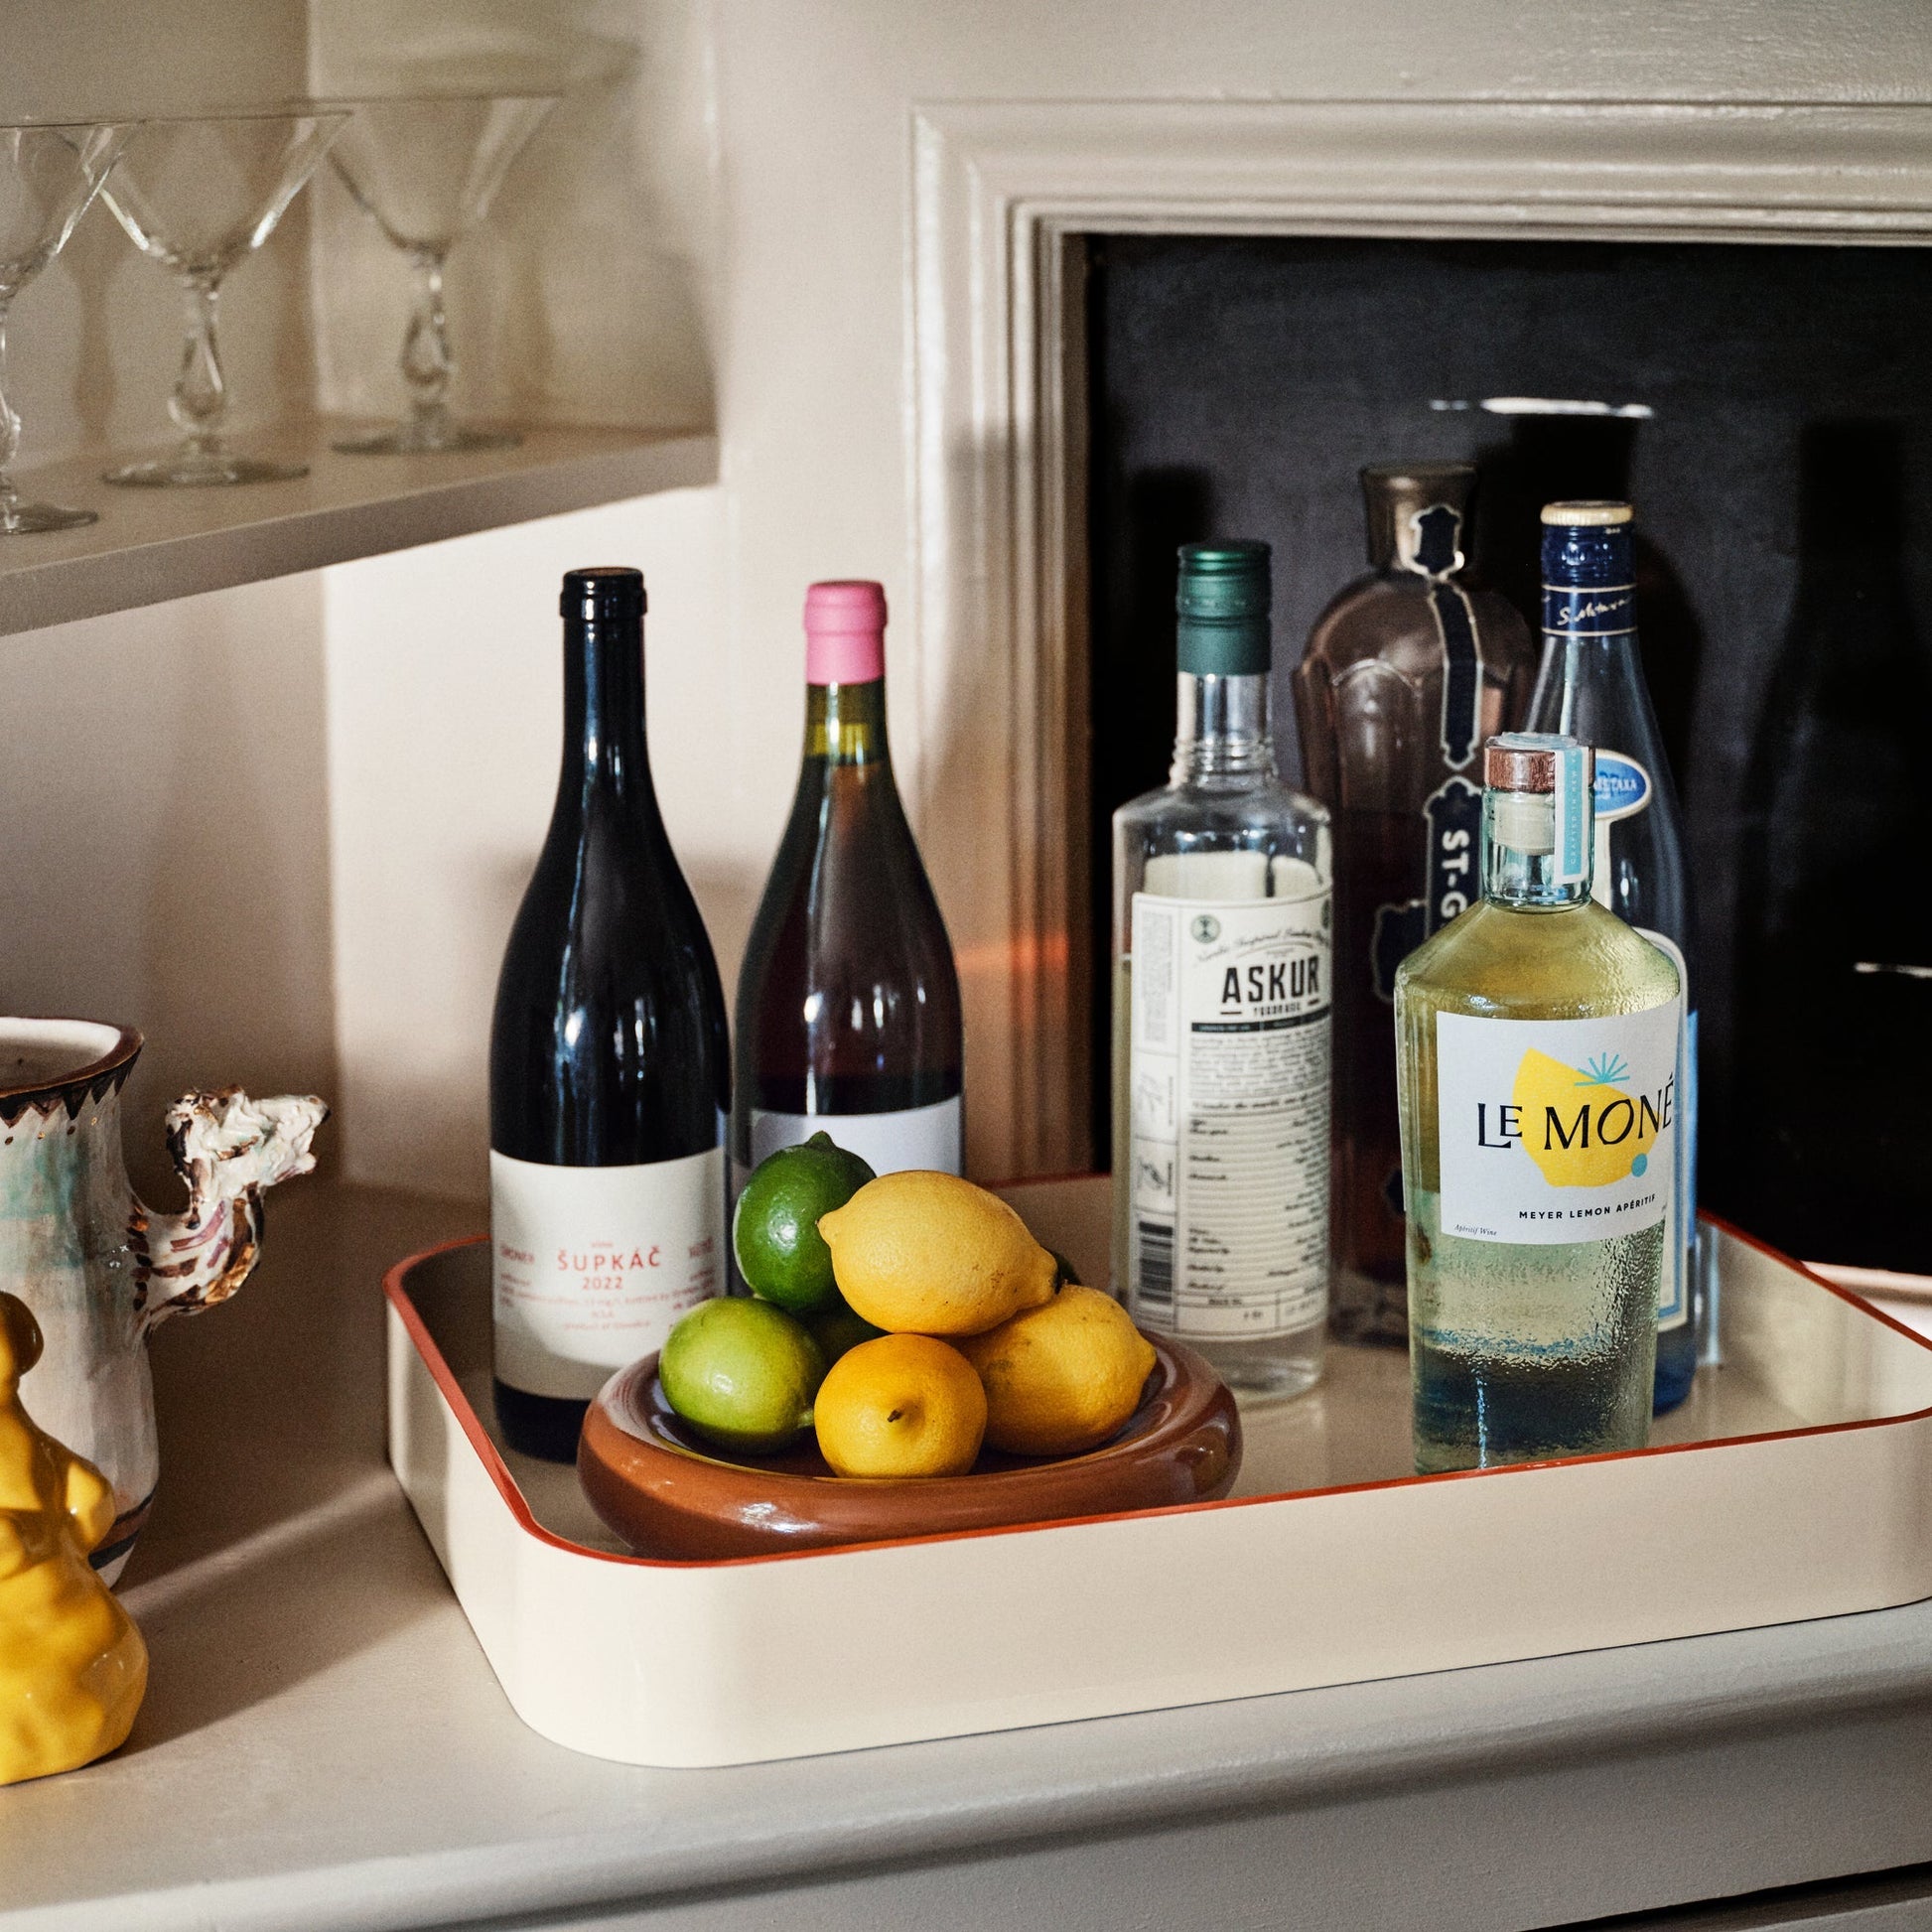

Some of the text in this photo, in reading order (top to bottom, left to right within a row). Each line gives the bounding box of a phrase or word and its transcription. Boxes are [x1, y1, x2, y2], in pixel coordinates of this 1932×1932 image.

[1441, 828, 1470, 919] ST-G
[1221, 956, 1319, 1004] ASKUR
[1477, 1073, 1675, 1150] LE MONÉ
[1519, 1211, 1563, 1220] MEYER
[1570, 1206, 1610, 1218] LEMON
[1615, 1193, 1655, 1212] APÉRITIF
[1479, 1227, 1497, 1236] Wine
[557, 1245, 661, 1271] ŠUPKÁČ
[582, 1277, 623, 1291] 2022
